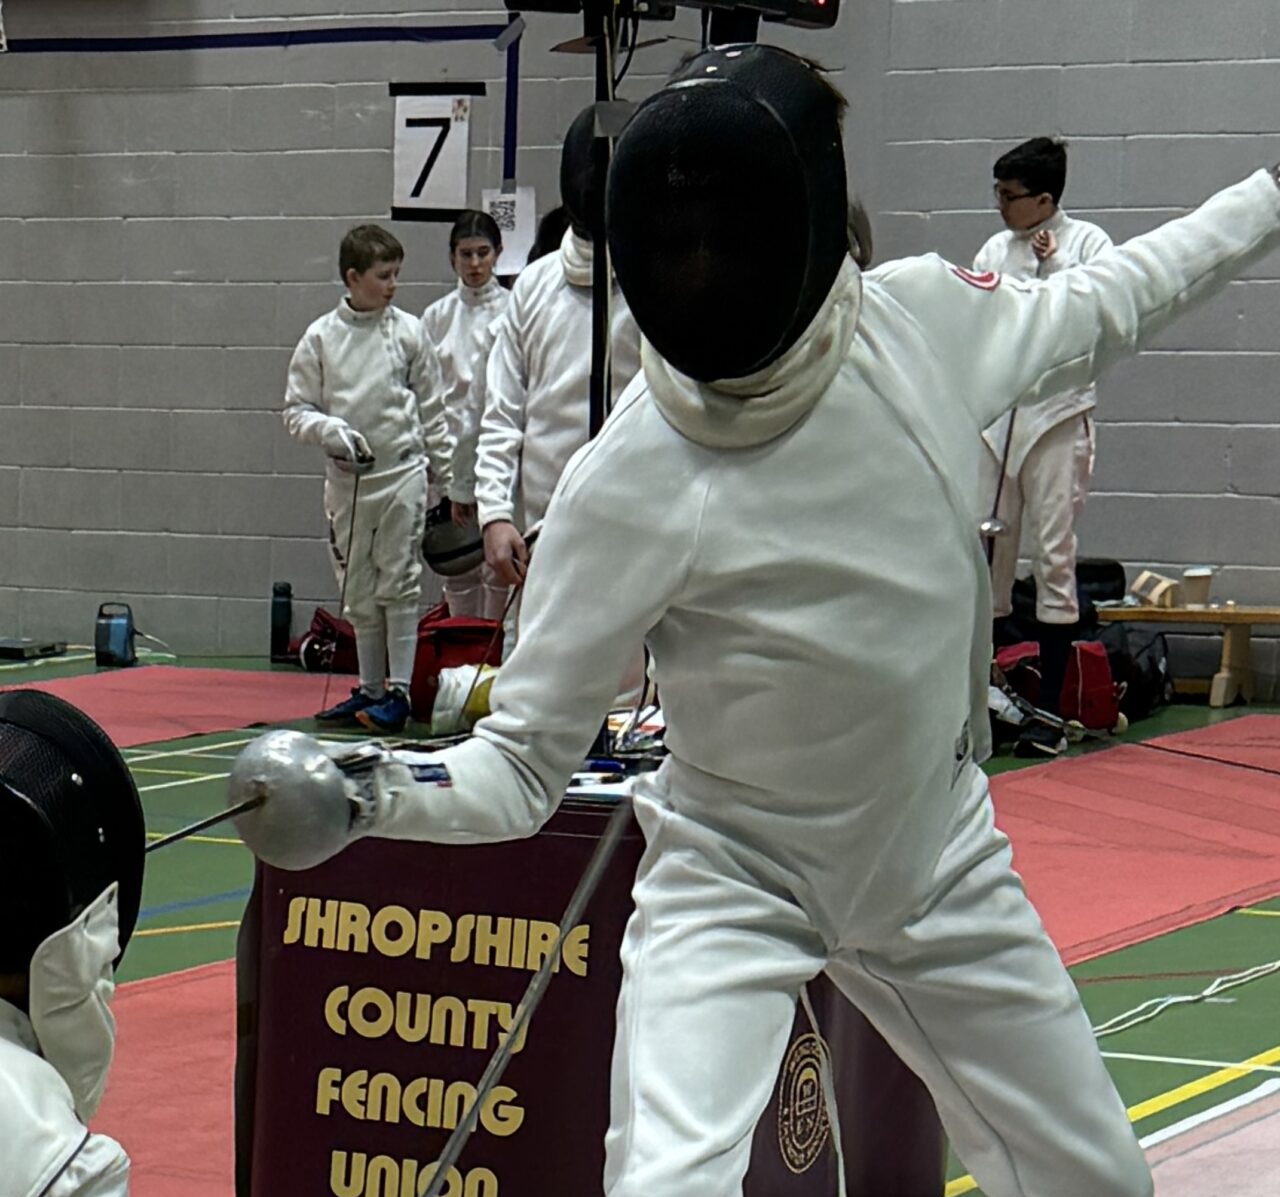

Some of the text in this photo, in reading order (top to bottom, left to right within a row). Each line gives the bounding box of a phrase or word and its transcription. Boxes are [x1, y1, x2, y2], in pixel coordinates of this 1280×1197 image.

[405, 117, 452, 198] 7
[282, 896, 591, 977] SHROPSHIRE
[324, 985, 530, 1055] COUNTY
[315, 1066, 526, 1137] FENCING
